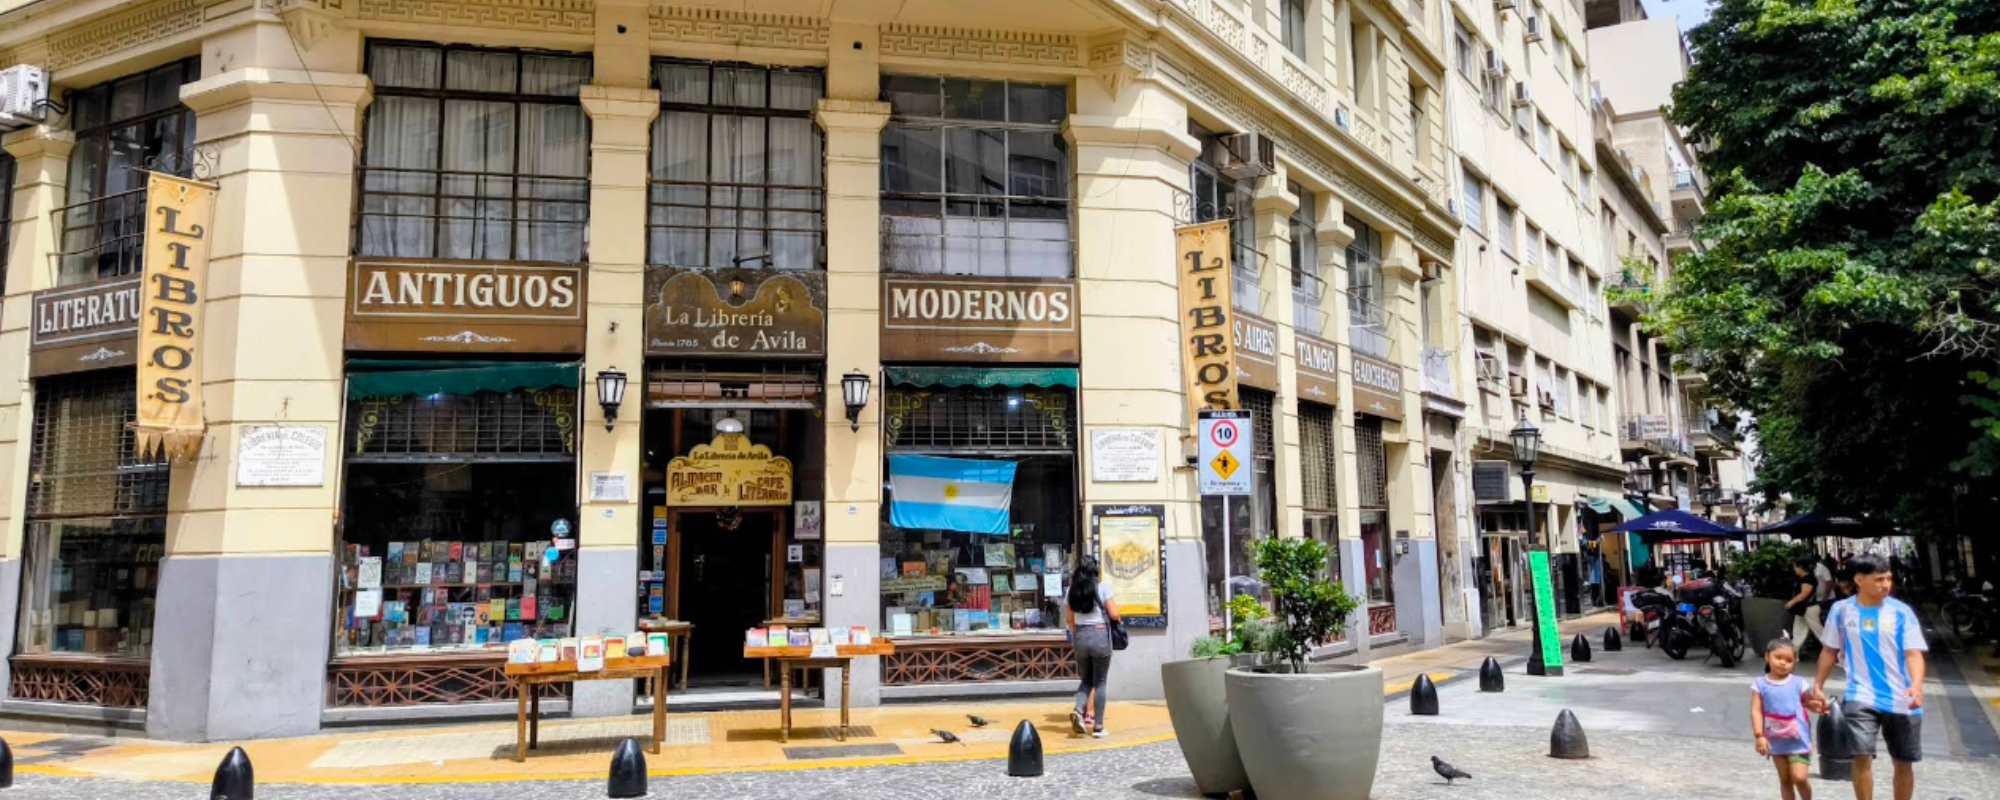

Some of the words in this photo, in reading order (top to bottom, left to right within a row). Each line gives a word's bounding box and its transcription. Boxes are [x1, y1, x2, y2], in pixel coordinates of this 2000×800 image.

[148, 205, 205, 404] LIBROS
[362, 270, 574, 308] ANTIGUOS
[892, 287, 1069, 322] MODERNOS
[665, 306, 689, 326] La
[693, 307, 773, 327] Librería
[1184, 250, 1230, 410] LIBROS
[711, 330, 740, 349] de
[750, 330, 807, 350] Avila
[1243, 323, 1275, 357] AIRES
[1297, 341, 1335, 374] TANGO
[1354, 360, 1400, 393] GAUCHESCO
[1217, 428, 1232, 439] 10
[738, 484, 789, 501] LITERARIO
